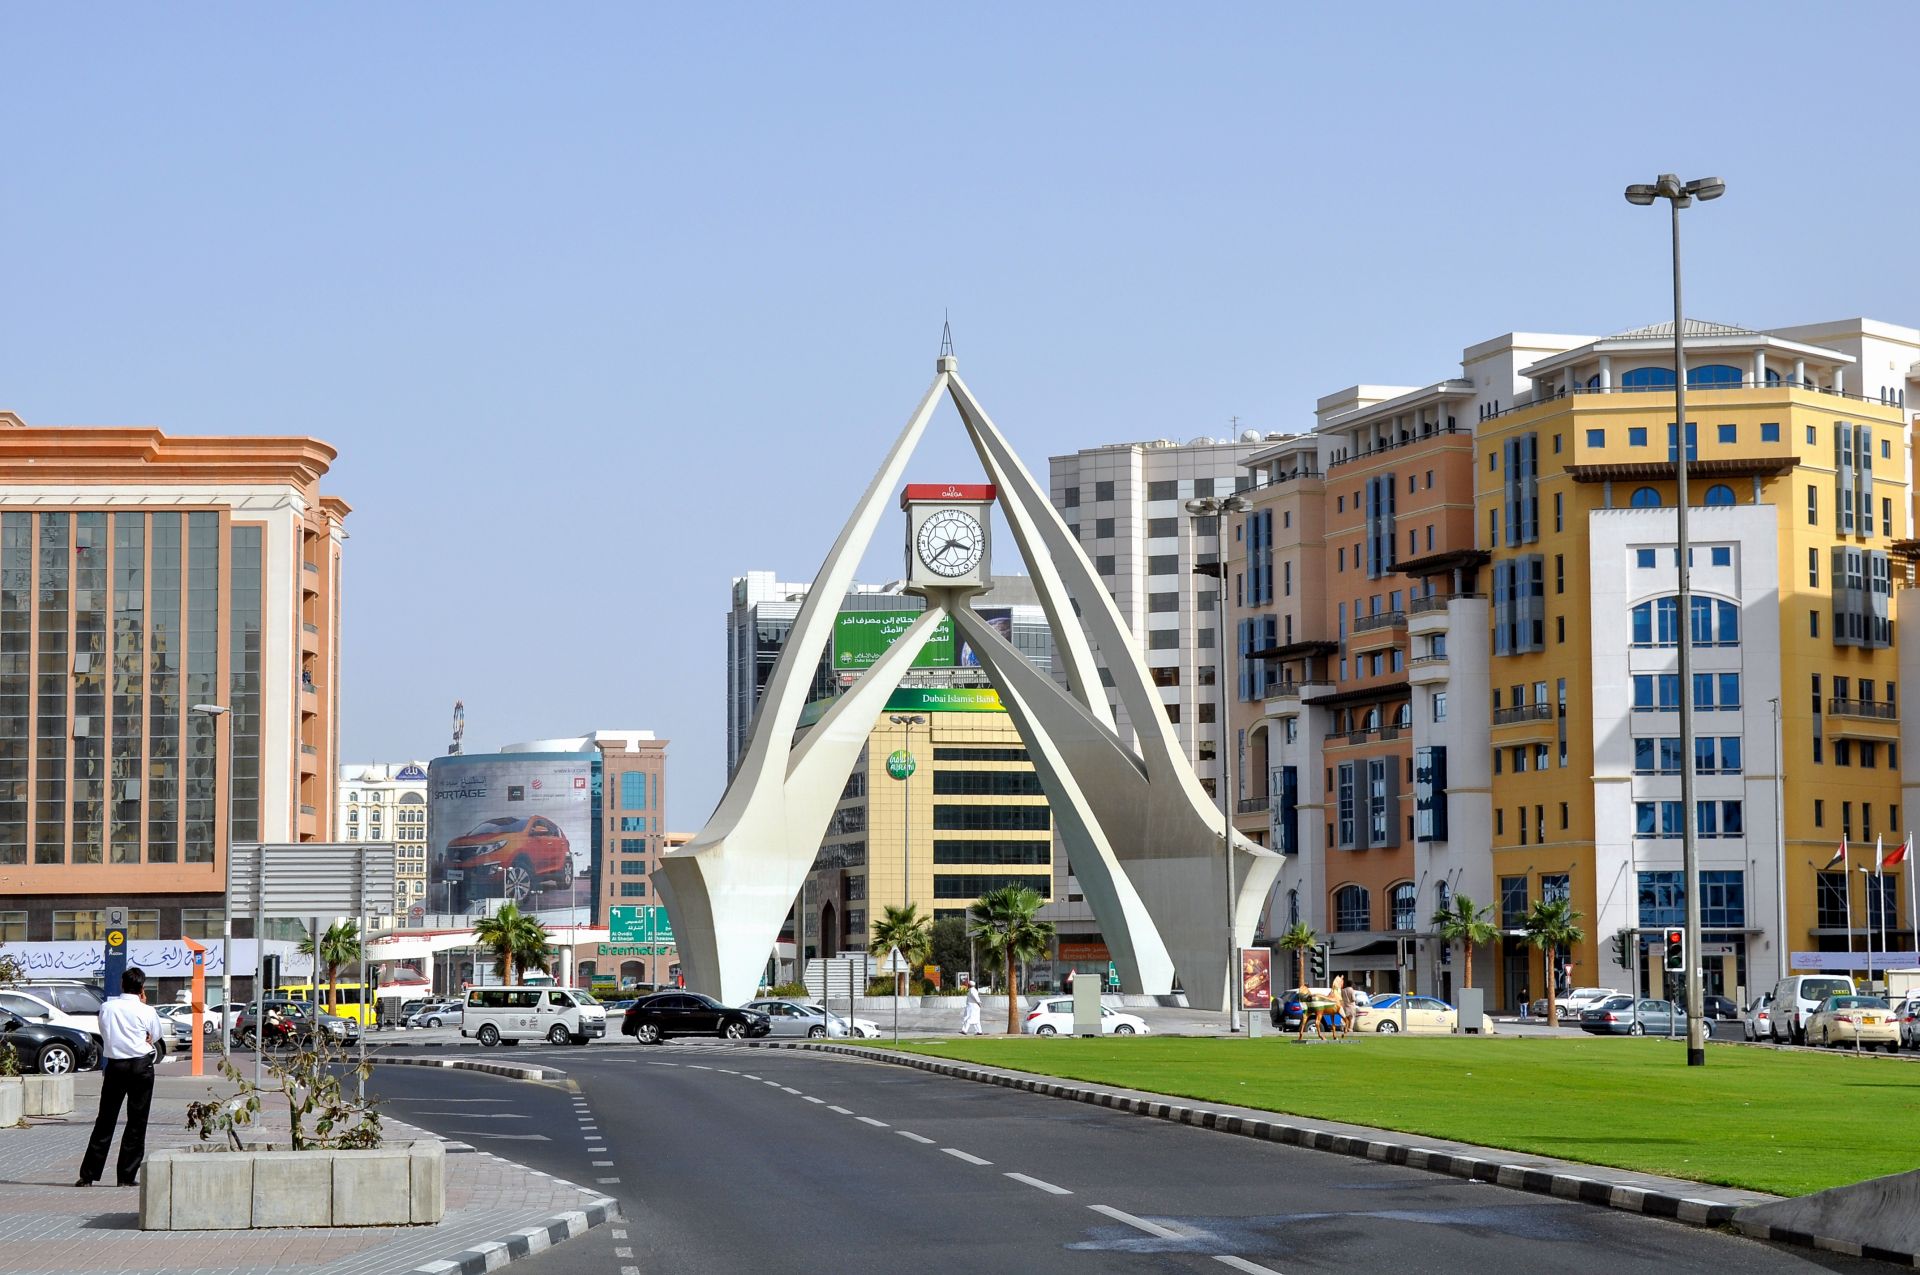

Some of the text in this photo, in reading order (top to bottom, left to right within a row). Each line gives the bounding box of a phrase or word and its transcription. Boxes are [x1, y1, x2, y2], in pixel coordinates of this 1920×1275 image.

[922, 694, 995, 703] Dubai Islamic Bank
[434, 788, 487, 801] SPORTAGE
[597, 944, 668, 956] Greenhouse
